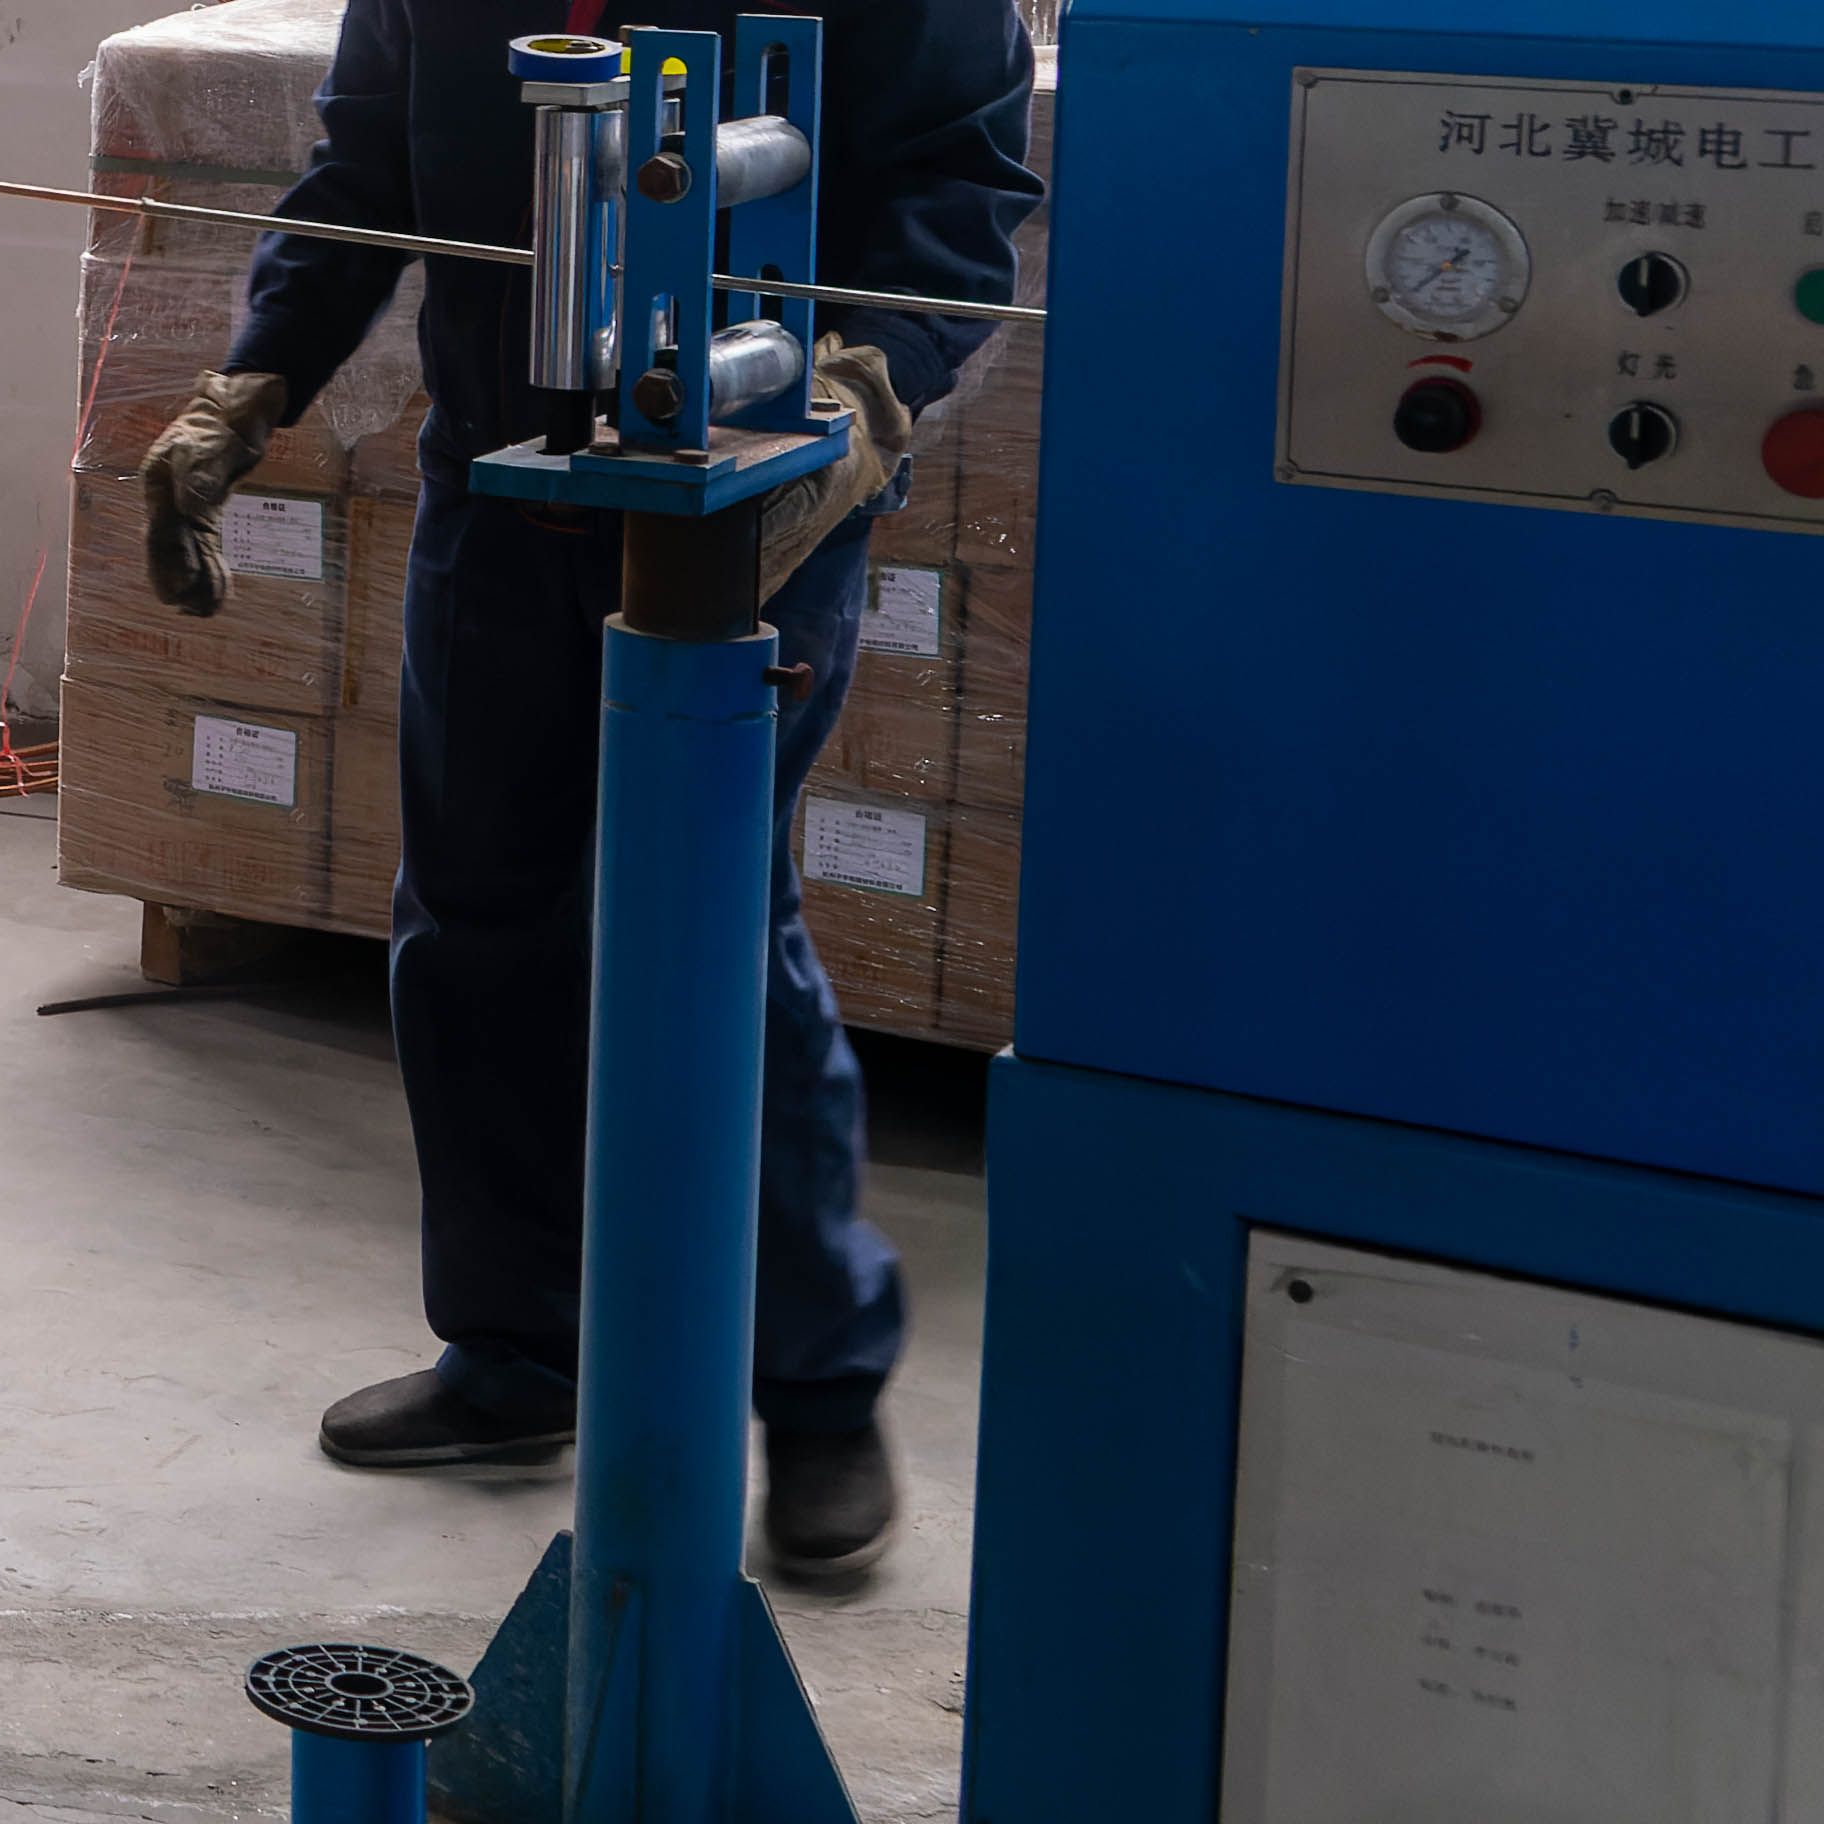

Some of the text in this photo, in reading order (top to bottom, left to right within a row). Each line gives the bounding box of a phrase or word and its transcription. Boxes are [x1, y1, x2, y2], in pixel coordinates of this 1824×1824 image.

[1439, 110, 1816, 171] 河北冀城电工
